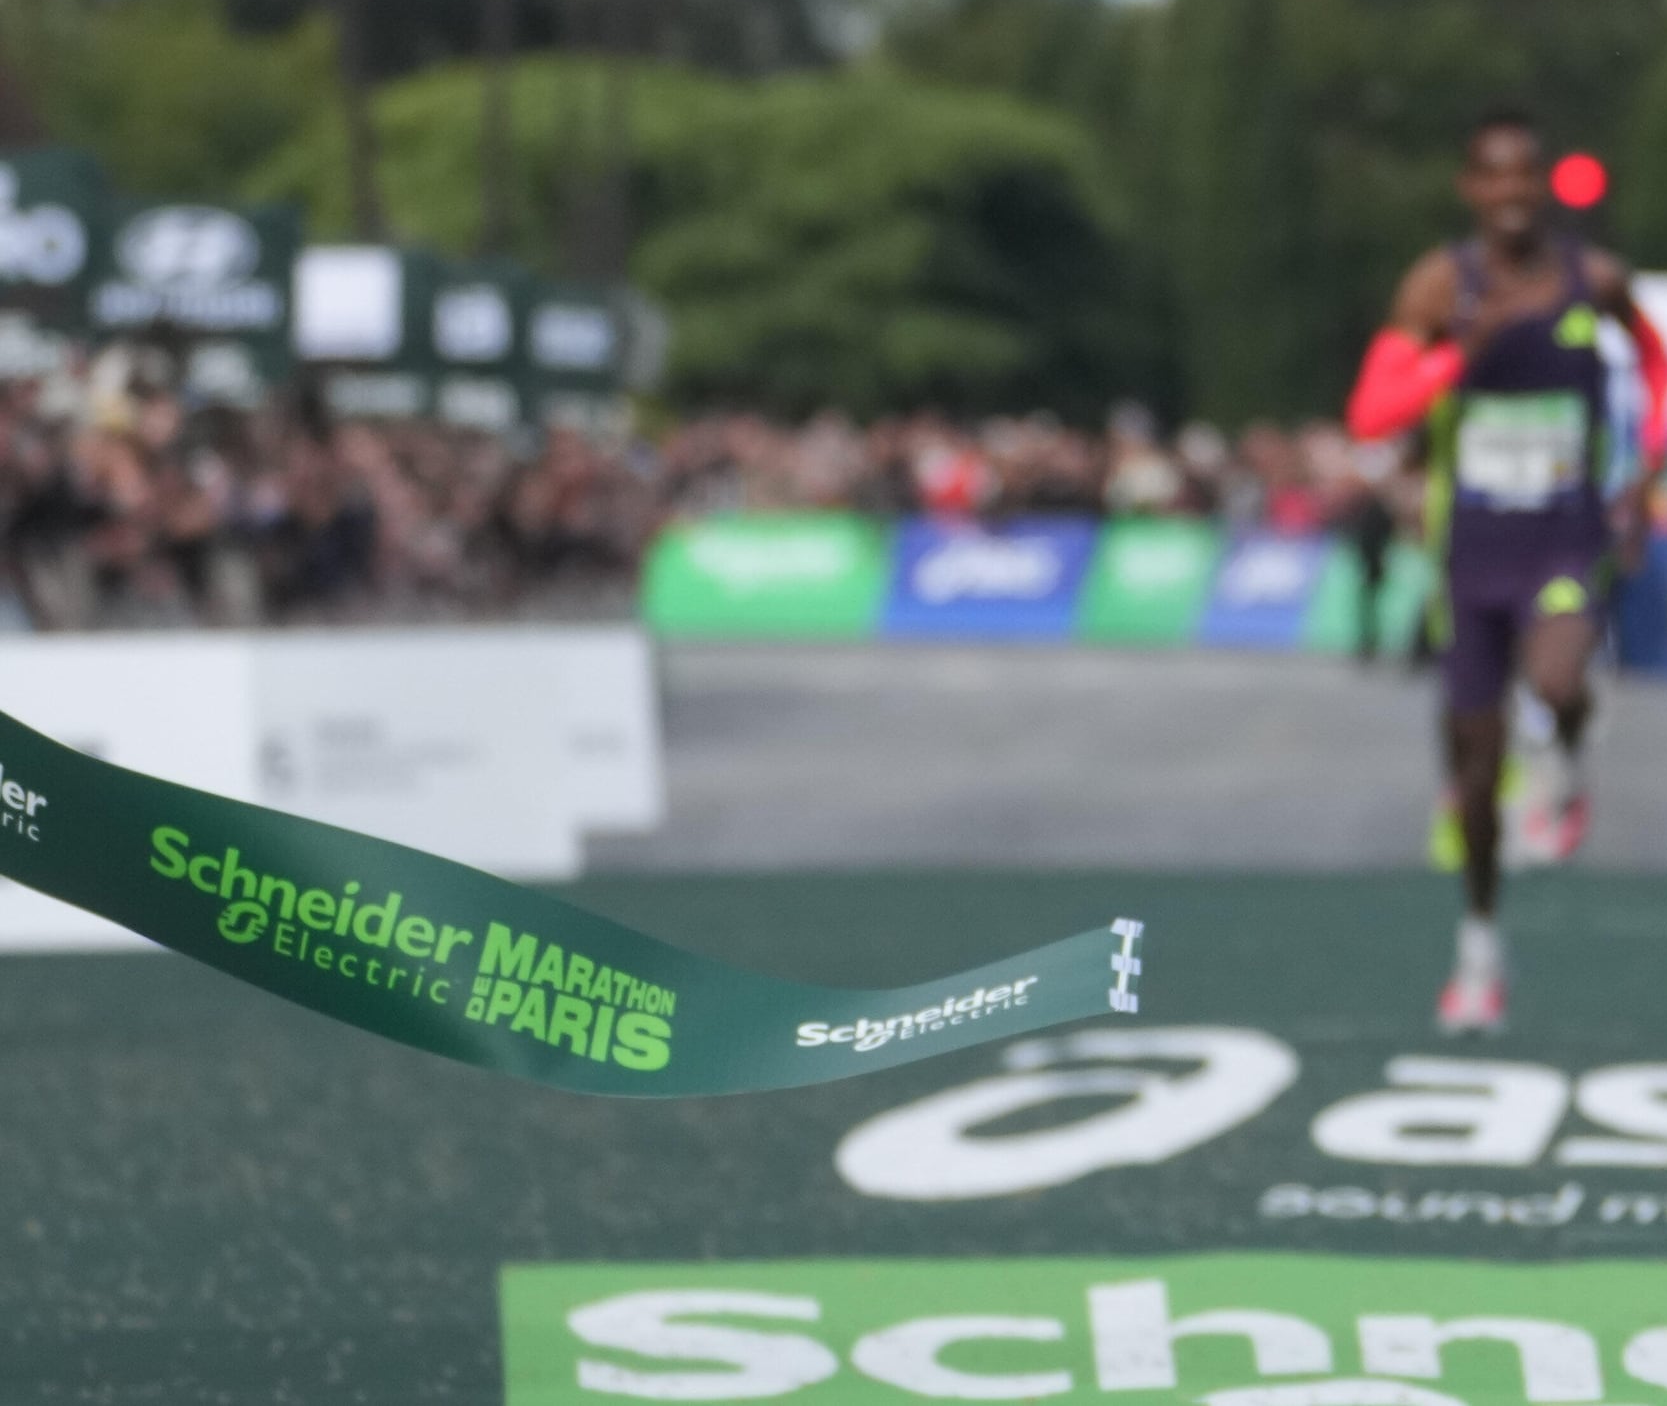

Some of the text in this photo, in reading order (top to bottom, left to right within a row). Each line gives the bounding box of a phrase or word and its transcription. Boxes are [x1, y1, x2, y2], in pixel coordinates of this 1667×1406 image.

[150, 826, 472, 965] Schneider
[274, 923, 451, 1004] Electric
[464, 975, 492, 1021] DE
[478, 920, 678, 1017] MARATHON
[485, 978, 672, 1072] PARIS
[797, 975, 1038, 1047] Schneider
[900, 994, 1029, 1041] Electric
[1258, 1182, 1585, 1226] sound
